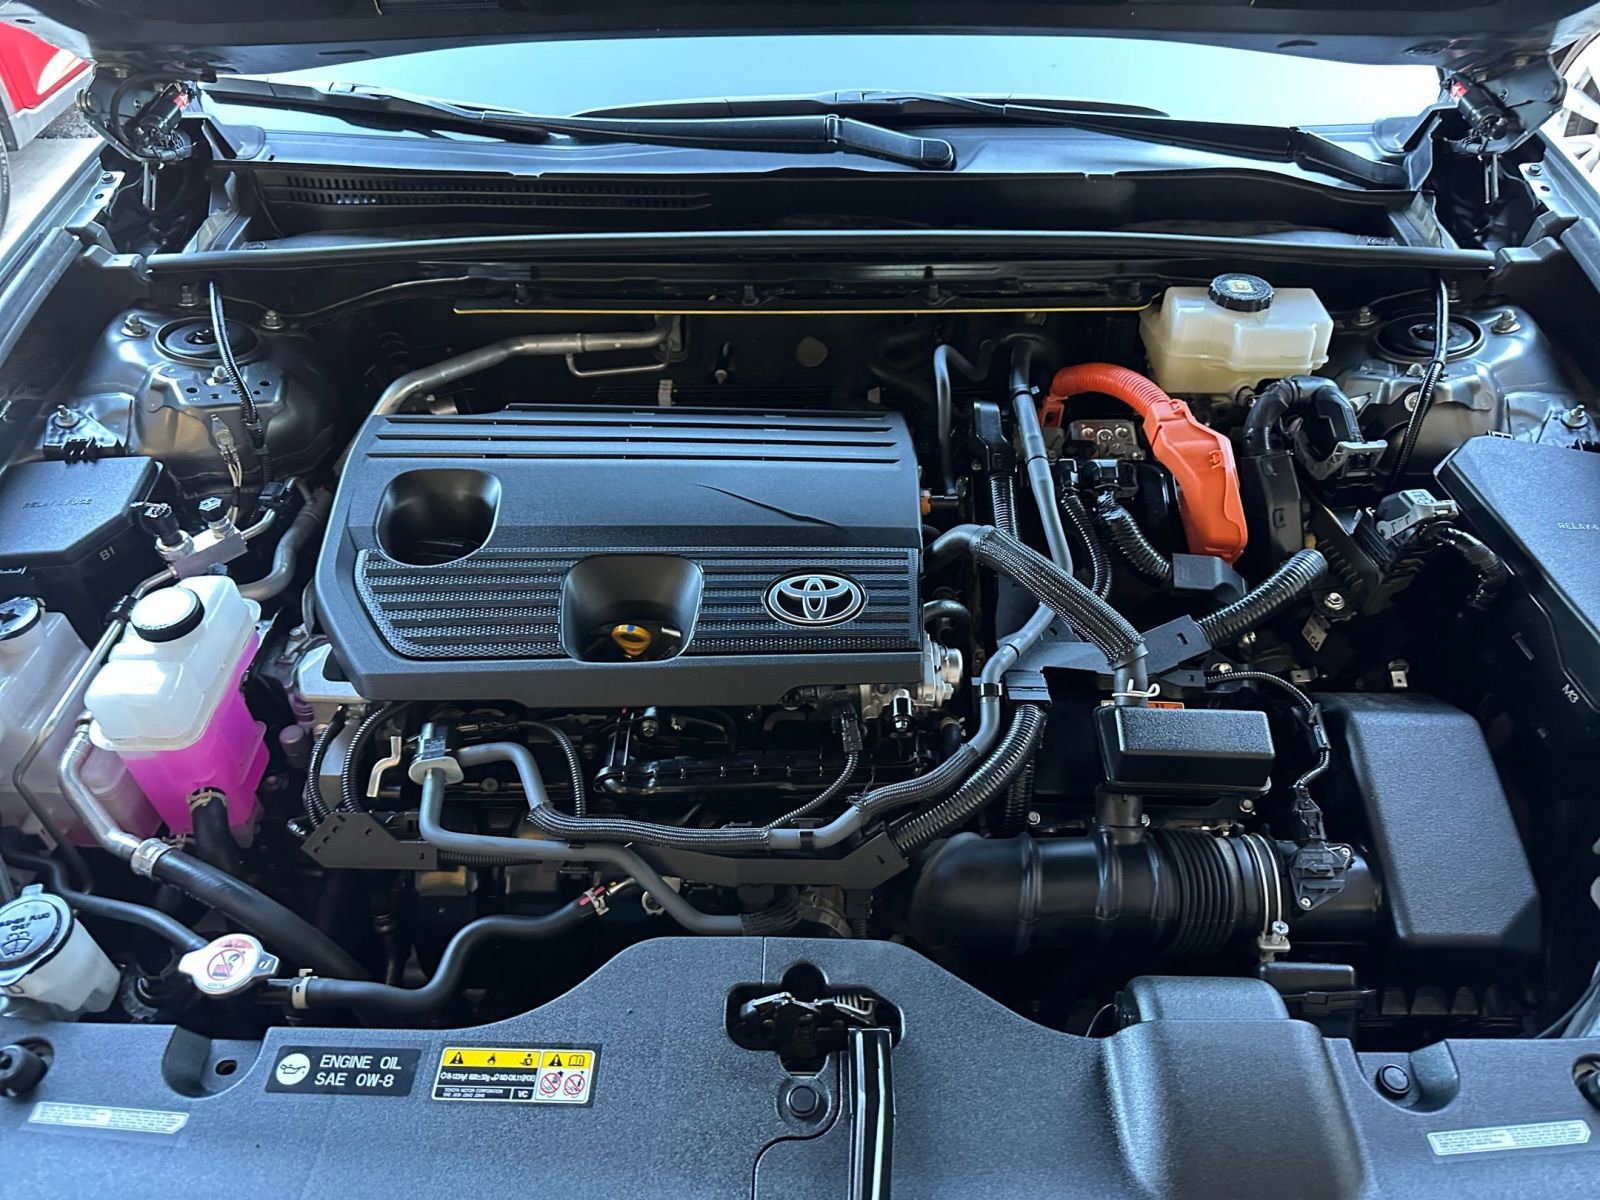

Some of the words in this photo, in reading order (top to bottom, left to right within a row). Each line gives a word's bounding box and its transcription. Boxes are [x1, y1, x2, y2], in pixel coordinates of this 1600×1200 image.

[1562, 683, 1579, 703] M3
[319, 1054, 373, 1068] ENGINE
[379, 1056, 402, 1070] OIL
[314, 1072, 348, 1086] SAE
[355, 1073, 395, 1087] 0W-8
[518, 1090, 528, 1098] VC
